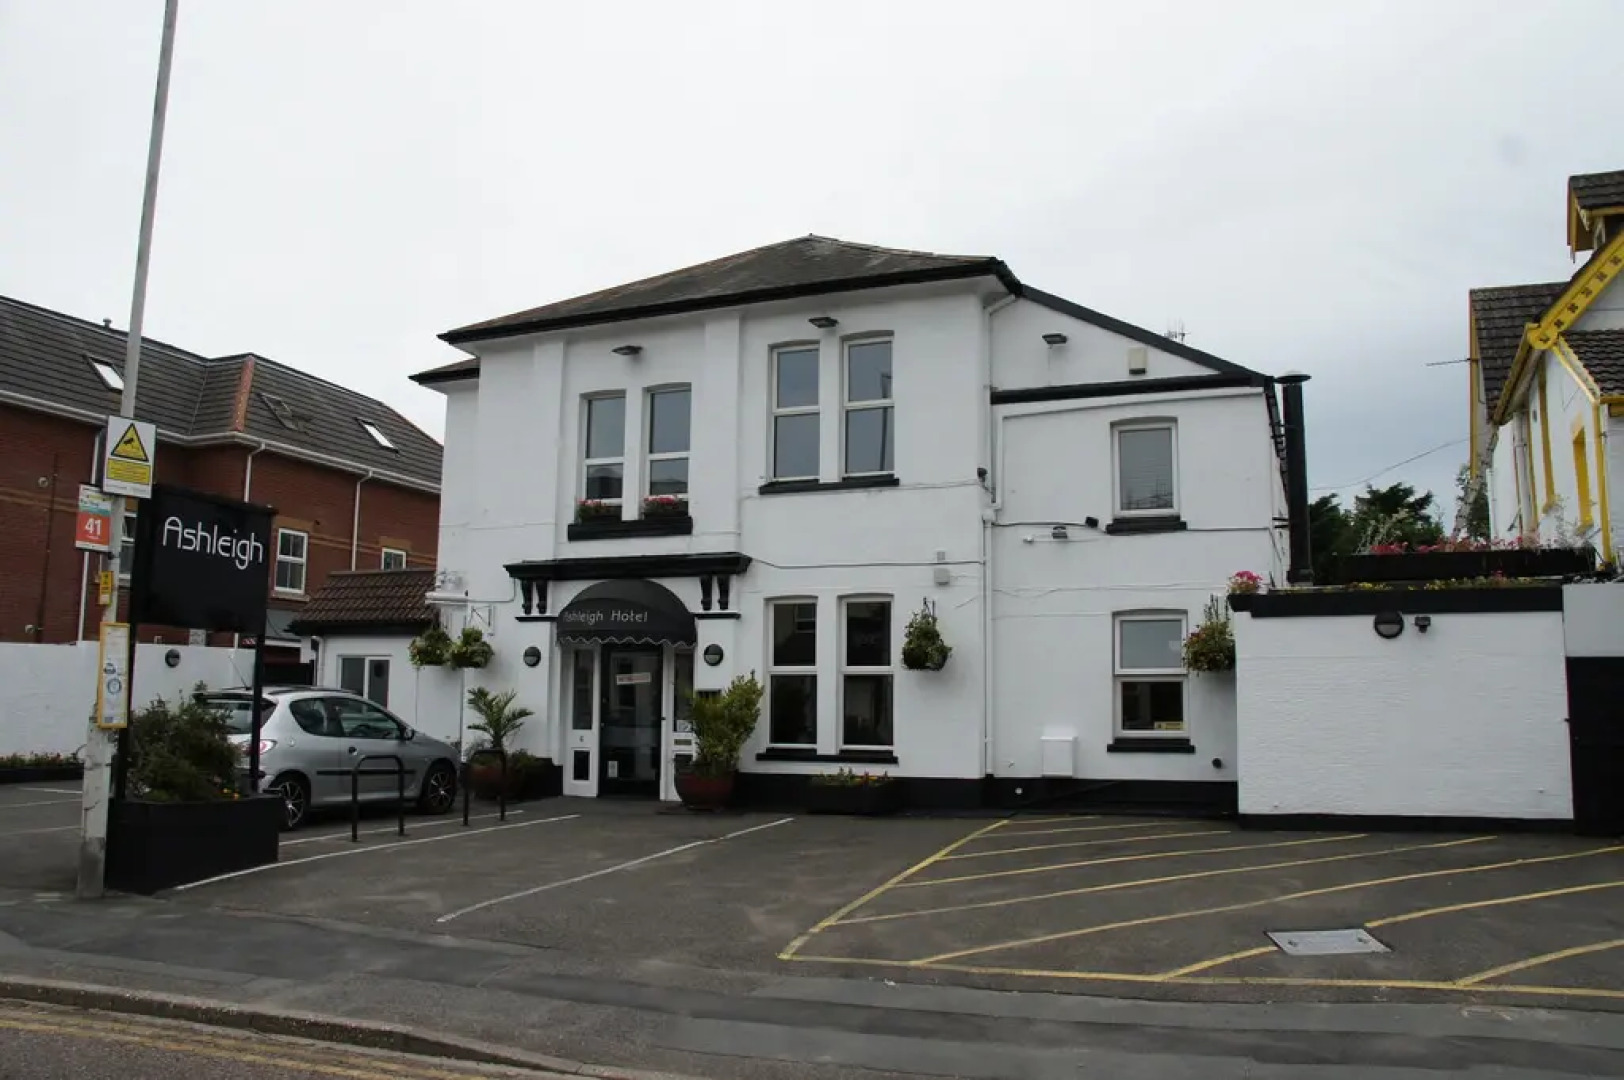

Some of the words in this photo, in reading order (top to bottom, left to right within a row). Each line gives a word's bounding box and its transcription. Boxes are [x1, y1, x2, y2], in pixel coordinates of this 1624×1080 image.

[85, 517, 101, 536] 41
[162, 516, 264, 570] Ashleigh
[611, 609, 648, 623] Hotel
